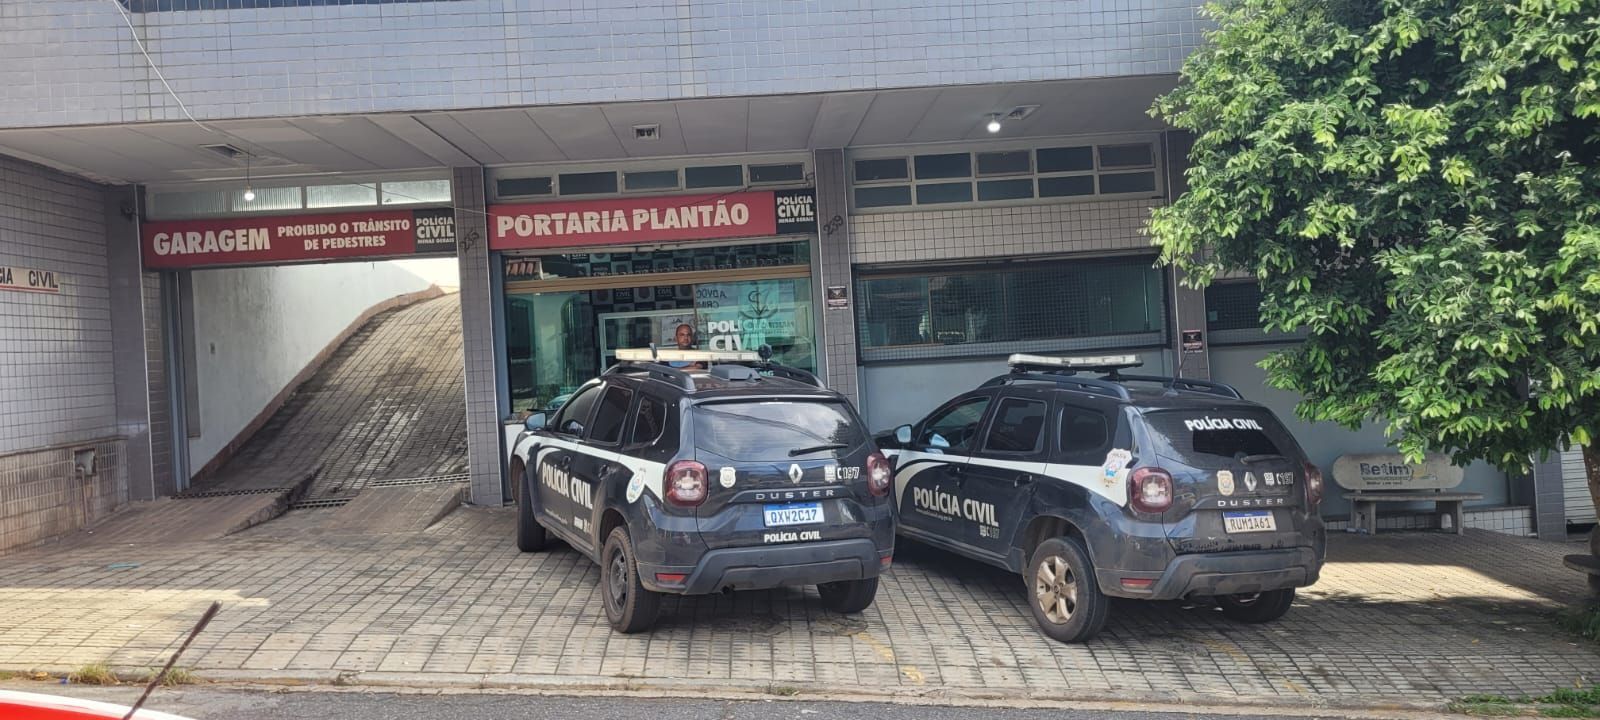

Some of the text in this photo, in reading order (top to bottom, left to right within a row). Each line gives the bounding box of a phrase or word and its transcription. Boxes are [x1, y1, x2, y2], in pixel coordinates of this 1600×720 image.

[777, 194, 813, 205] POLÍCIA
[777, 204, 814, 217] CIVIL
[416, 215, 454, 226] POLÍCIA
[497, 199, 749, 238] PORTARIA PLANTÃO
[823, 215, 844, 235] 239
[277, 218, 410, 237] PROIBIDO O TRÂNSITO
[416, 225, 455, 238] CIVIL
[153, 227, 271, 255] GARAGEM
[304, 235, 386, 251] DE PEDESTRES
[29, 270, 58, 288] CIVIL
[1184, 416, 1263, 431] POLÍCIA CIVIL
[1360, 463, 1409, 476] Betim
[542, 461, 593, 510] POLÍCIA CIVIL
[756, 490, 835, 500] DUSTER
[913, 484, 961, 517] POLÍCIA
[963, 498, 999, 527] CIVIL
[1217, 498, 1284, 507] DUSTER
[1230, 517, 1271, 530] RUM1A61
[764, 530, 821, 543] POLÍCIA CIVIL
